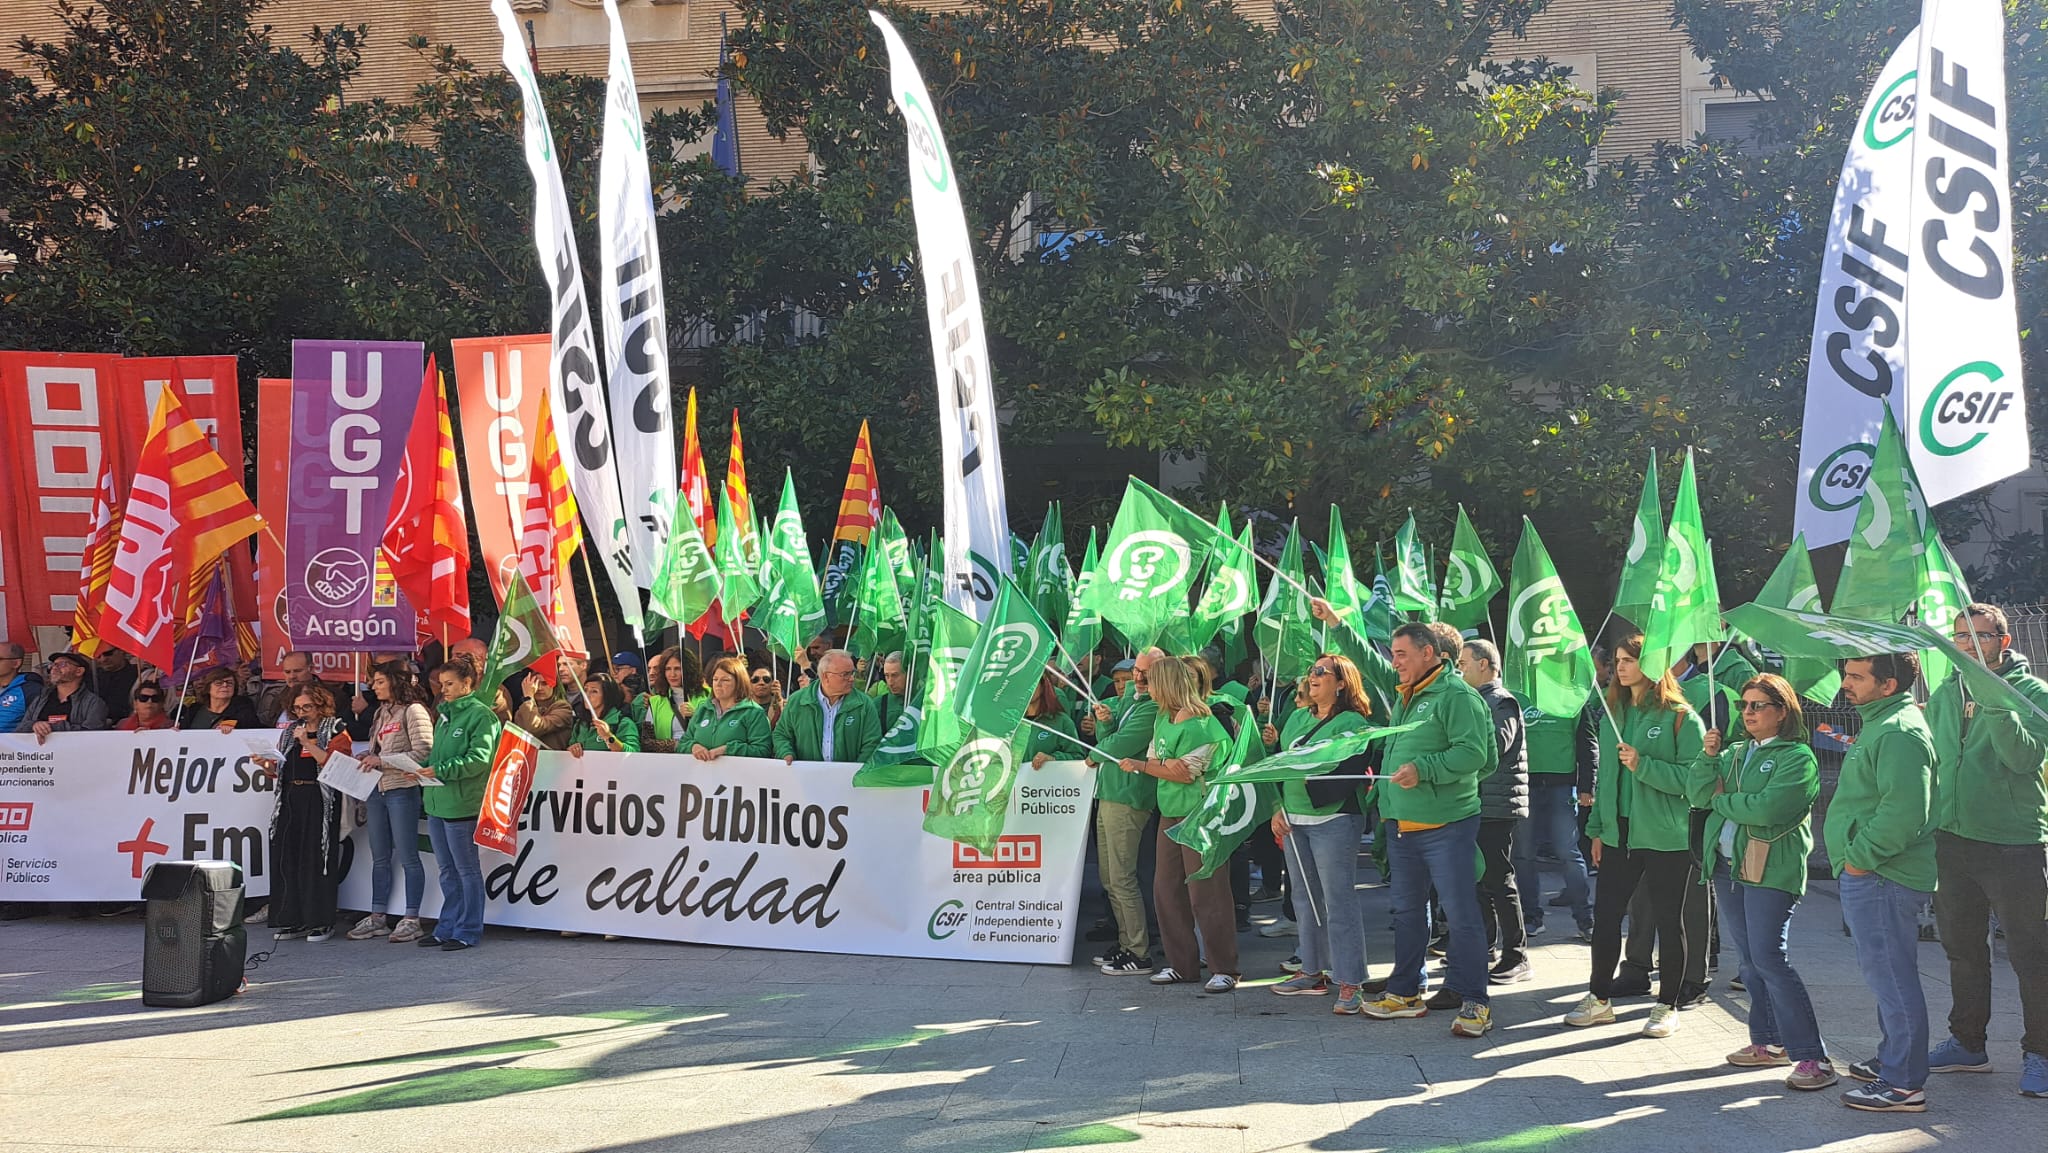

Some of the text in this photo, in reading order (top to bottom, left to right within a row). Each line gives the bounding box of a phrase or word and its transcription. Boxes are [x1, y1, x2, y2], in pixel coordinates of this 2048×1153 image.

[1922, 46, 2004, 299] CSIF
[1827, 203, 1909, 398] CSIF
[1937, 391, 2014, 424] CSIF
[329, 350, 383, 535] UGT
[482, 349, 531, 542] UGT
[1825, 463, 1872, 490] CSI
[305, 615, 397, 642] Aragón
[17, 752, 54, 761] Sindical
[48, 767, 54, 775] y
[127, 746, 226, 802] Mejor
[494, 757, 524, 818] UGT
[1021, 786, 1081, 798] Servicios
[516, 778, 665, 838] ervicios
[676, 783, 849, 851] Públicos
[1021, 802, 1076, 815] Públicos
[7, 858, 57, 869] Servicios
[6, 872, 50, 883] Públicos
[484, 839, 846, 929] de calidad
[952, 869, 1041, 886] área pública
[975, 900, 1063, 912] Central Sindical
[936, 912, 968, 927] CSIF
[974, 916, 1062, 930] Independiente y
[972, 931, 1060, 944] de Funcionario
